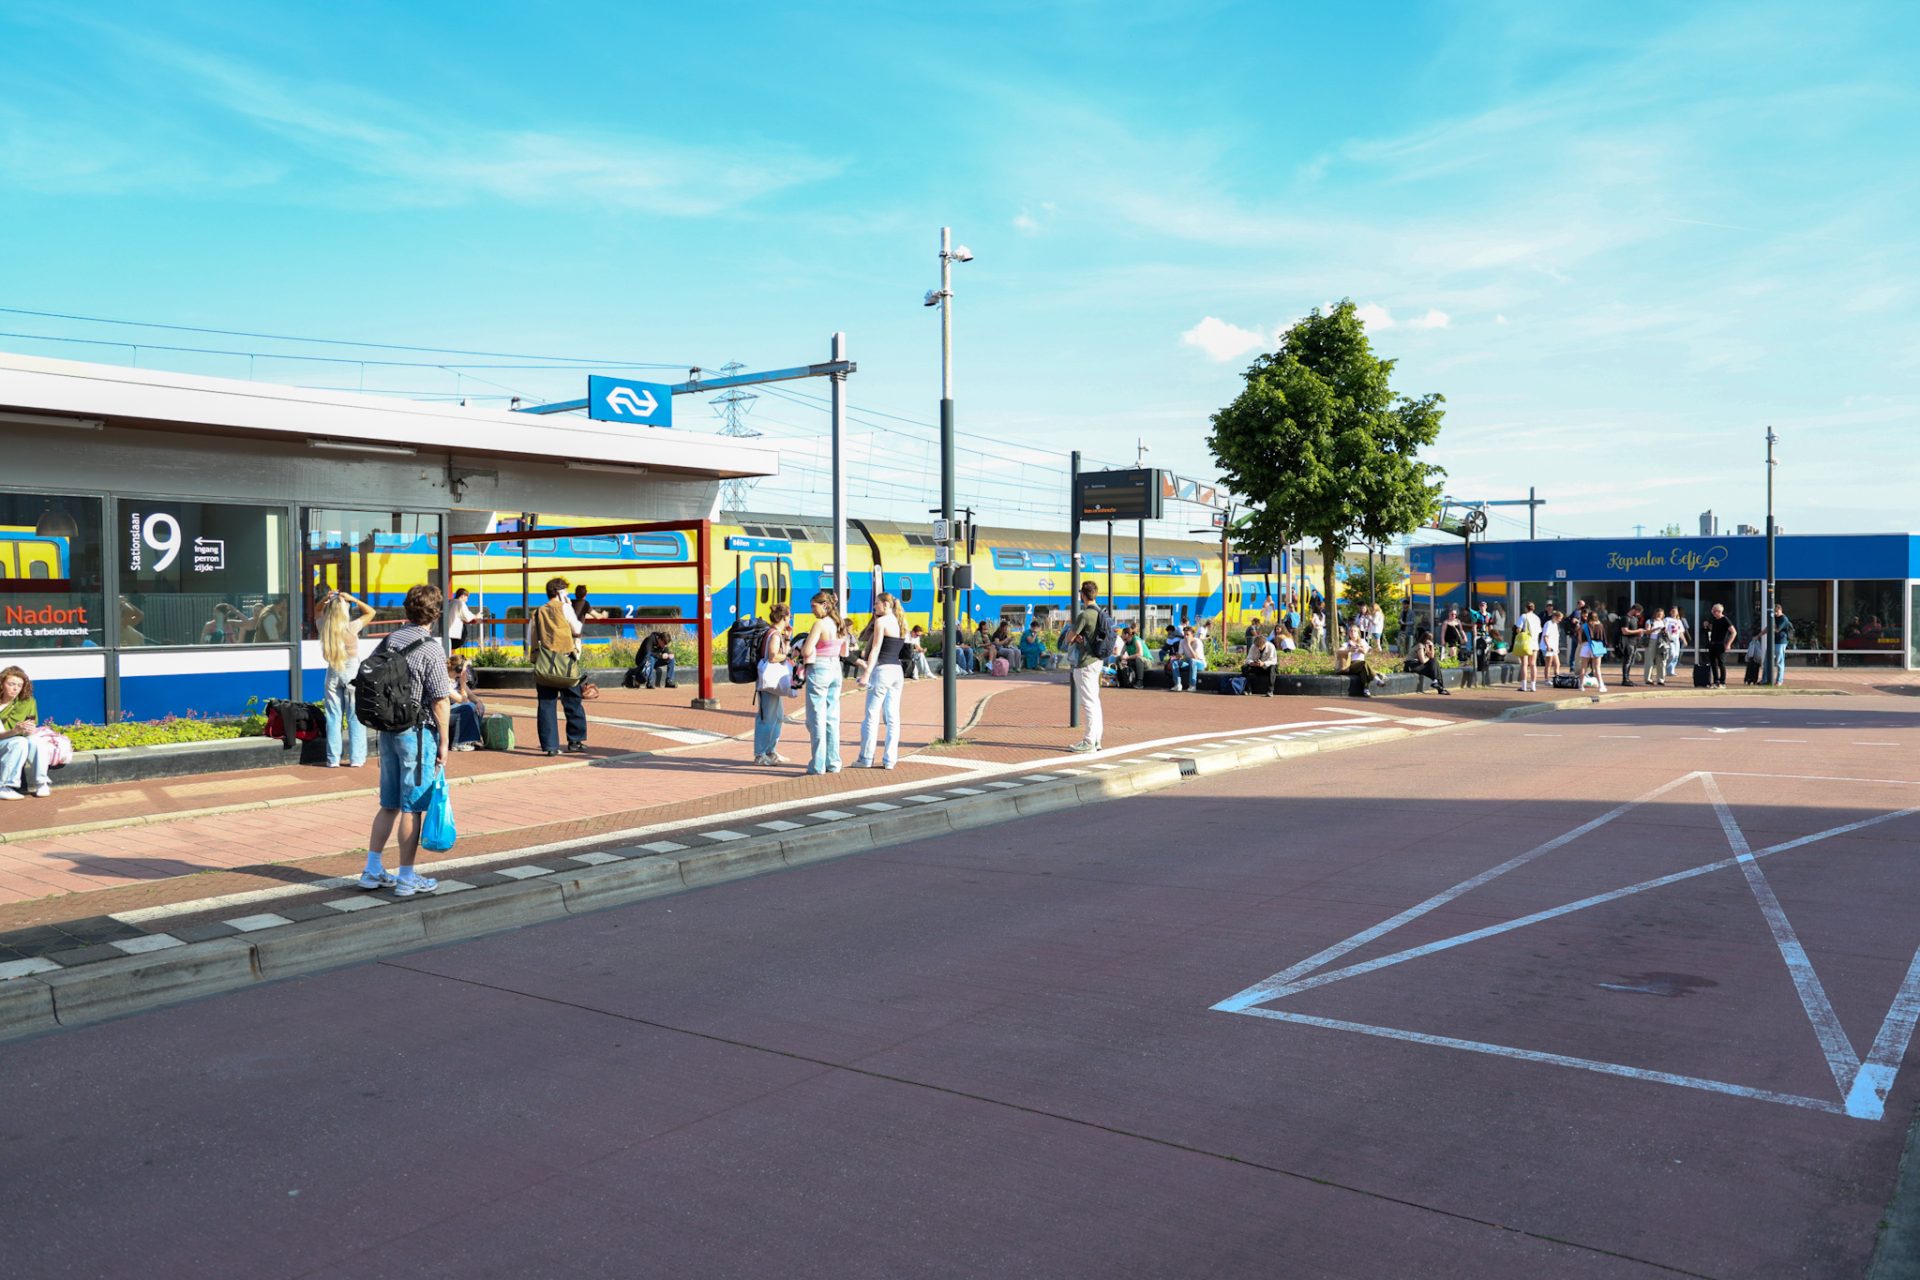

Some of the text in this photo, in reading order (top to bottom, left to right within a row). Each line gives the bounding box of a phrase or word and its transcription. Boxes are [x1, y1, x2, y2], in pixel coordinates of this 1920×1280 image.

[130, 512, 141, 571] Stationslaan
[143, 512, 181, 572] 9
[622, 533, 631, 545] 2
[194, 555, 219, 563] perron
[1607, 550, 1665, 572] Kapsalon
[194, 563, 214, 572] zijde
[6, 605, 87, 624] Nadort
[625, 605, 634, 618] 2
[1027, 604, 1033, 614] 2
[24, 628, 33, 636] &
[34, 627, 89, 636] arbeidsrecht
